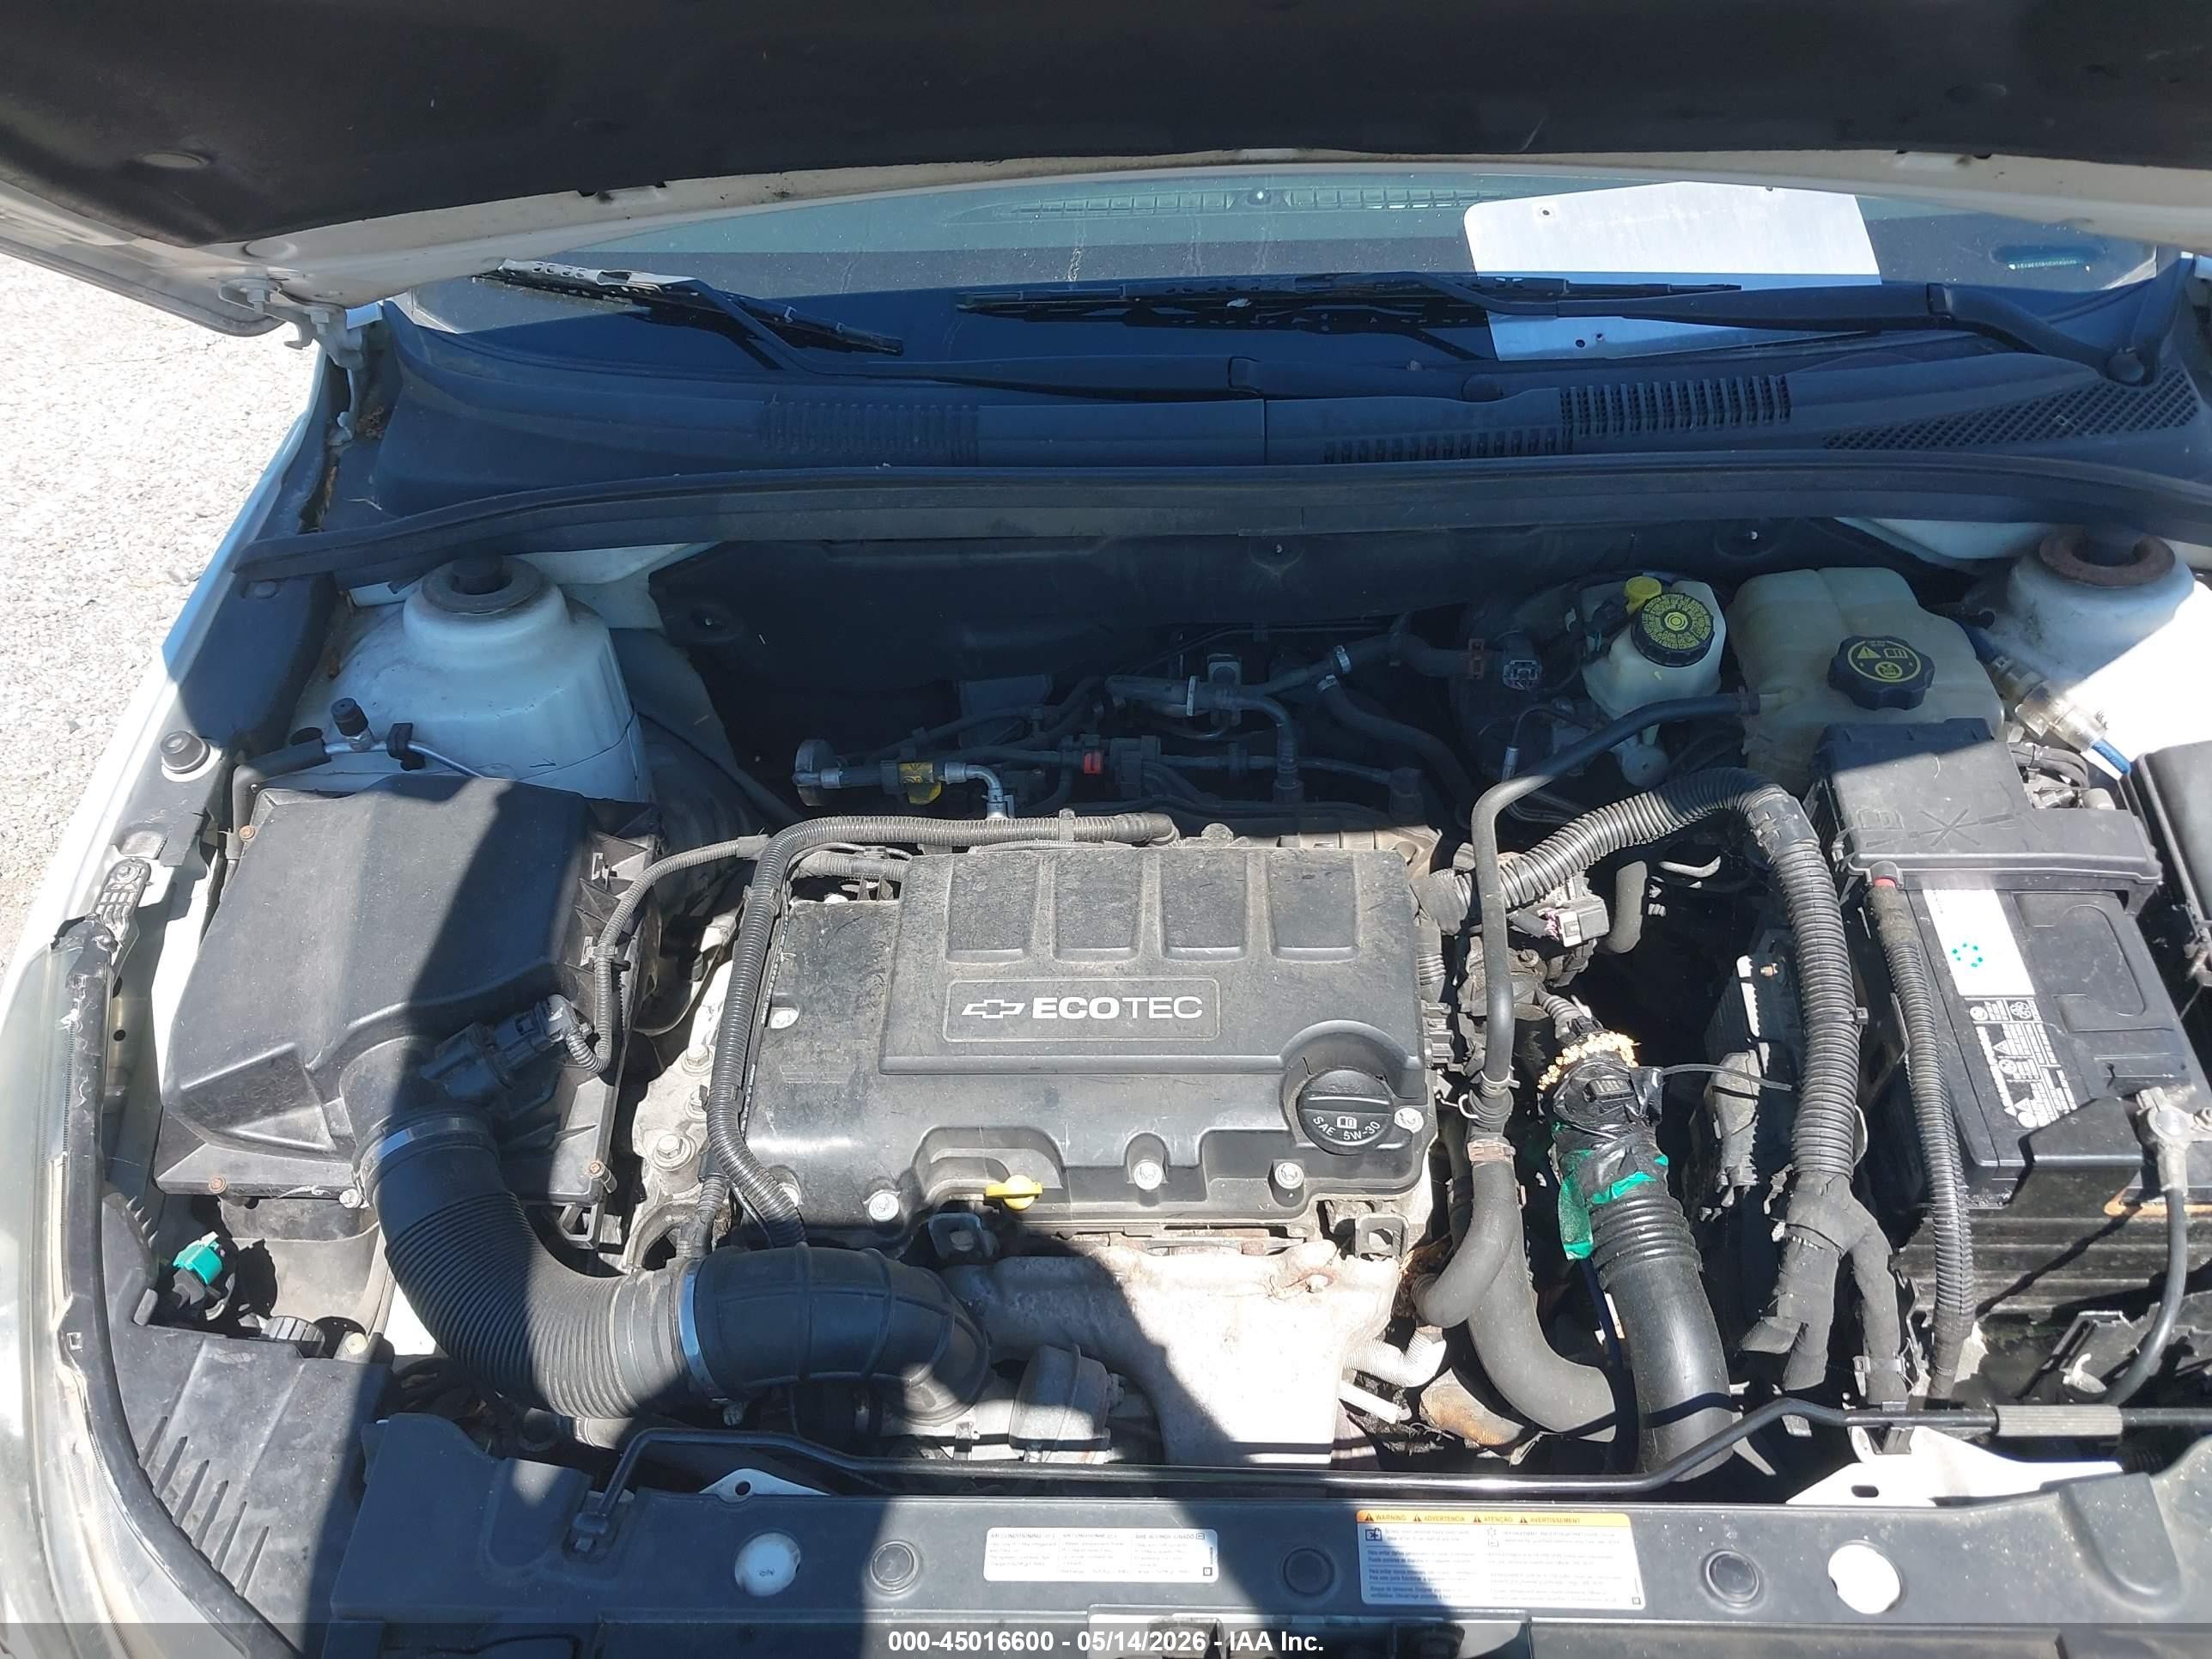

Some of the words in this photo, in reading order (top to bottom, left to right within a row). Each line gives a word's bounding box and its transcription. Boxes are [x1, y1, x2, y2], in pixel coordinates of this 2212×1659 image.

[1032, 996, 1203, 1020] ECOTEC
[1312, 1116, 1336, 1137] SAE
[1343, 1120, 1381, 1141] 5W-30
